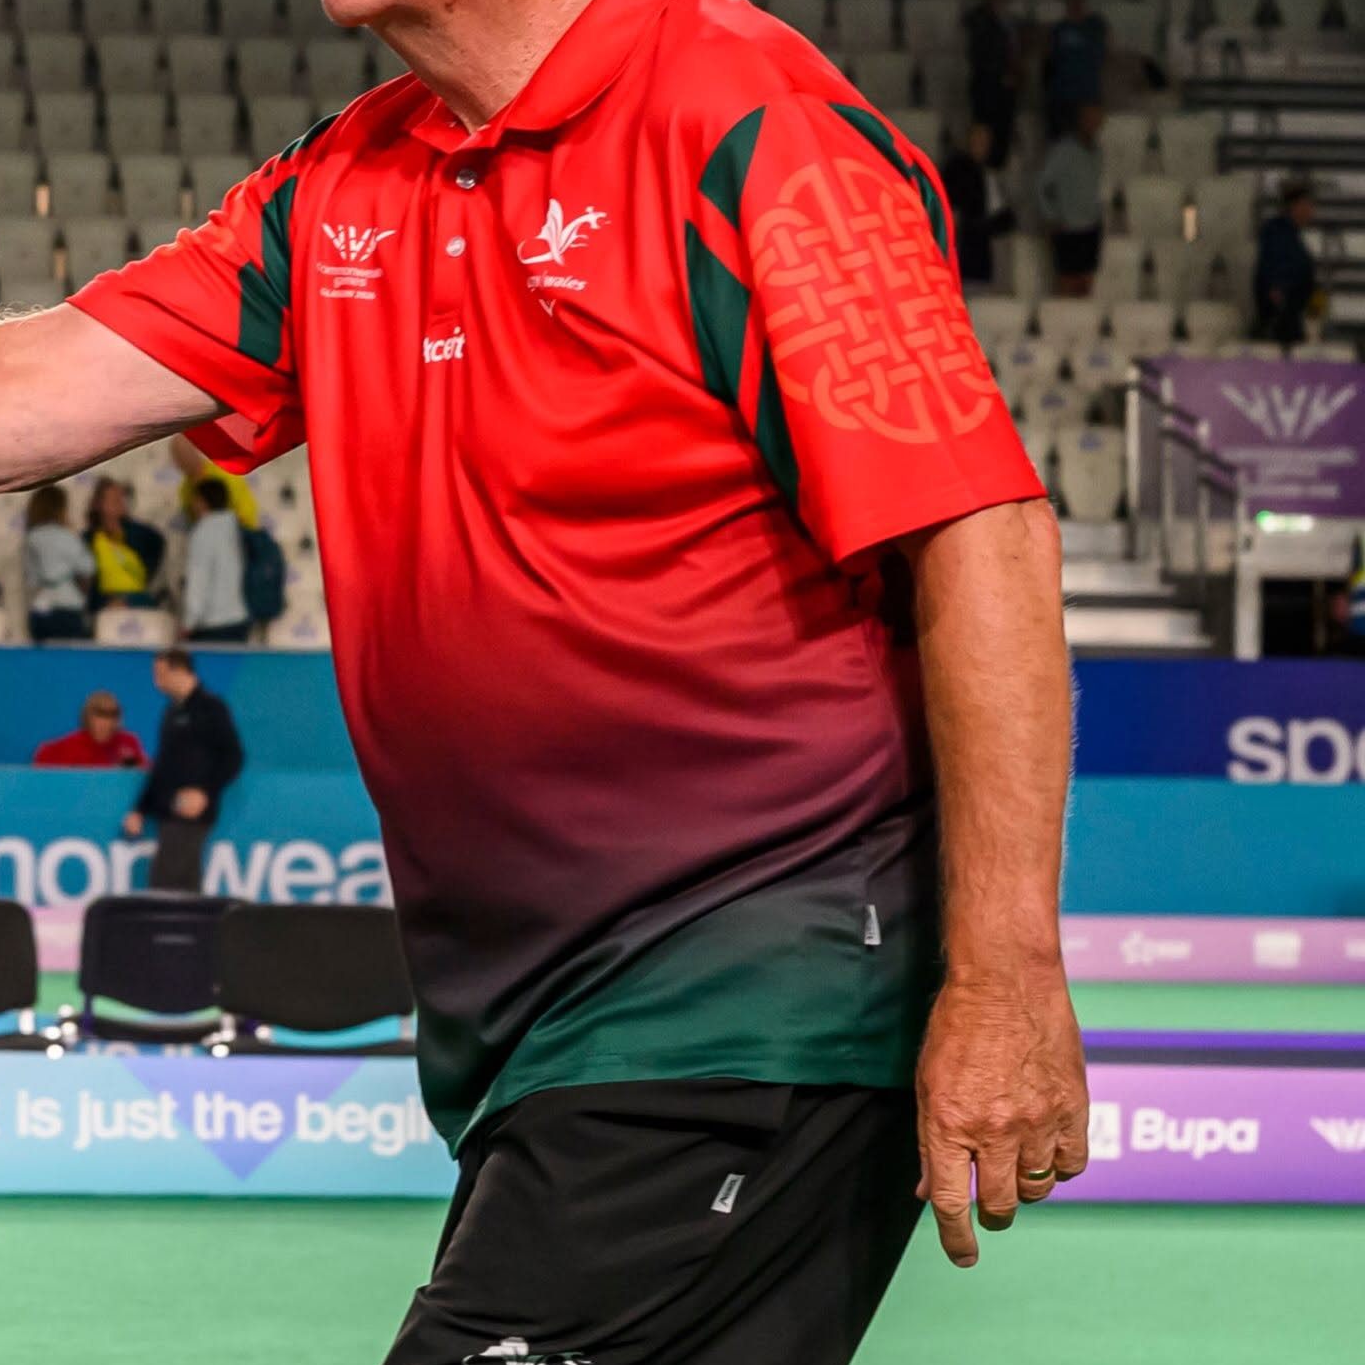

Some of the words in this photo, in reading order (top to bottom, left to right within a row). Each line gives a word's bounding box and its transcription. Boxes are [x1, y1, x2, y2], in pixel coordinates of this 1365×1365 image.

[1227, 714, 1365, 786] sp
[17, 1089, 64, 1140] is
[72, 1090, 179, 1151] just
[193, 1090, 285, 1142] the
[1130, 1107, 1260, 1160] Bupa
